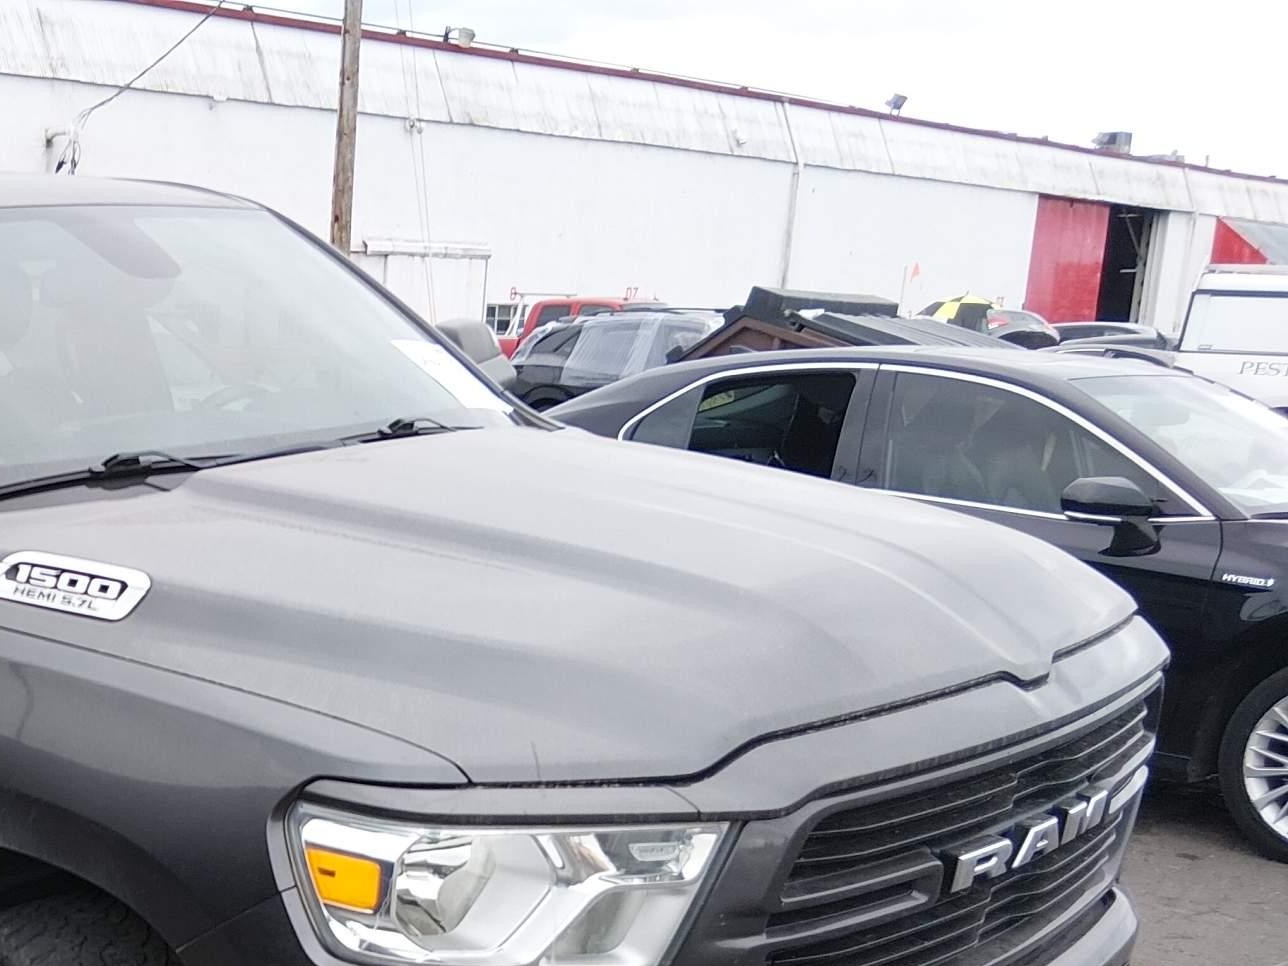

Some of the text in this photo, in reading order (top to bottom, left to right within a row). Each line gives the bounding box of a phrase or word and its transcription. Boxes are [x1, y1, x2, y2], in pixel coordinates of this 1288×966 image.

[15, 563, 123, 600] 1500
[1222, 573, 1268, 587] HYBRID
[12, 585, 98, 611] HEMI 5.7L
[948, 785, 1110, 894] RAM
